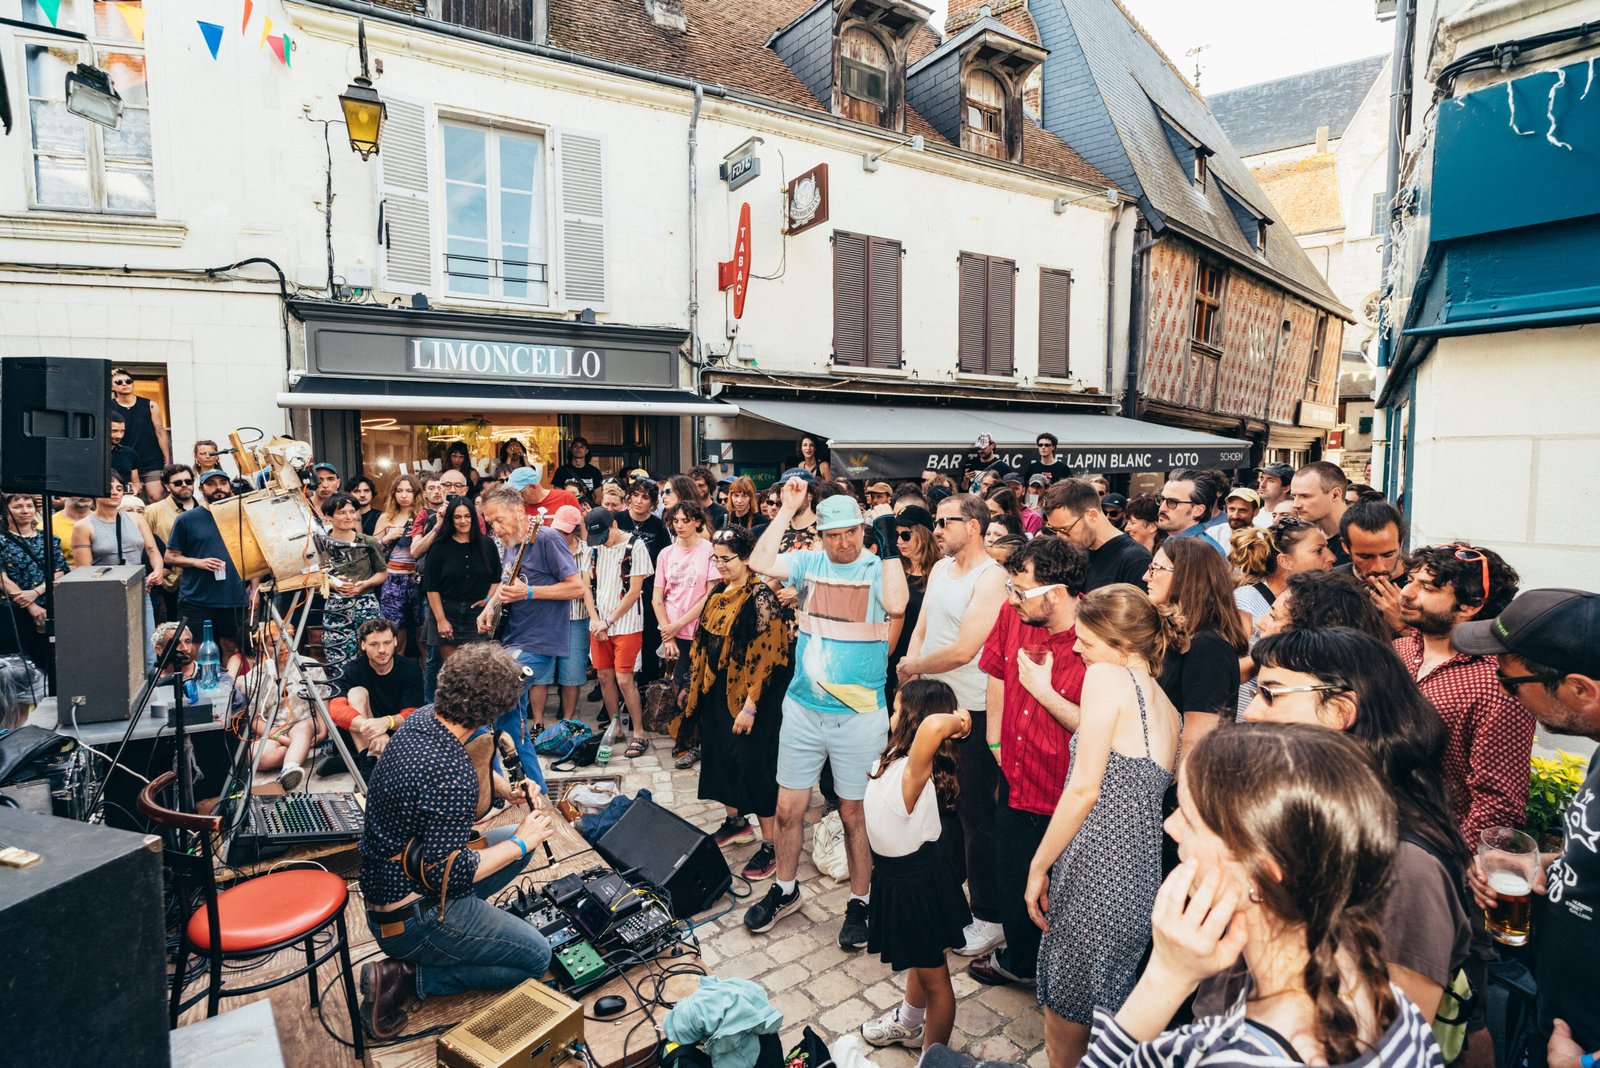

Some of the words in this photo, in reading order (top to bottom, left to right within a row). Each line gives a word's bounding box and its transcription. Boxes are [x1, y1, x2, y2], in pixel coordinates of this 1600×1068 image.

[732, 161, 745, 178] FDJ
[736, 227, 746, 295] TABAC
[411, 340, 601, 378] LIMONCELLO
[926, 454, 962, 470] BAR
[1066, 453, 1106, 468] LAPIN
[1110, 453, 1152, 468] BLANC
[1168, 453, 1199, 467] LOTO
[1219, 452, 1243, 462] SCHOEN
[1569, 907, 1592, 921] GALLERY
